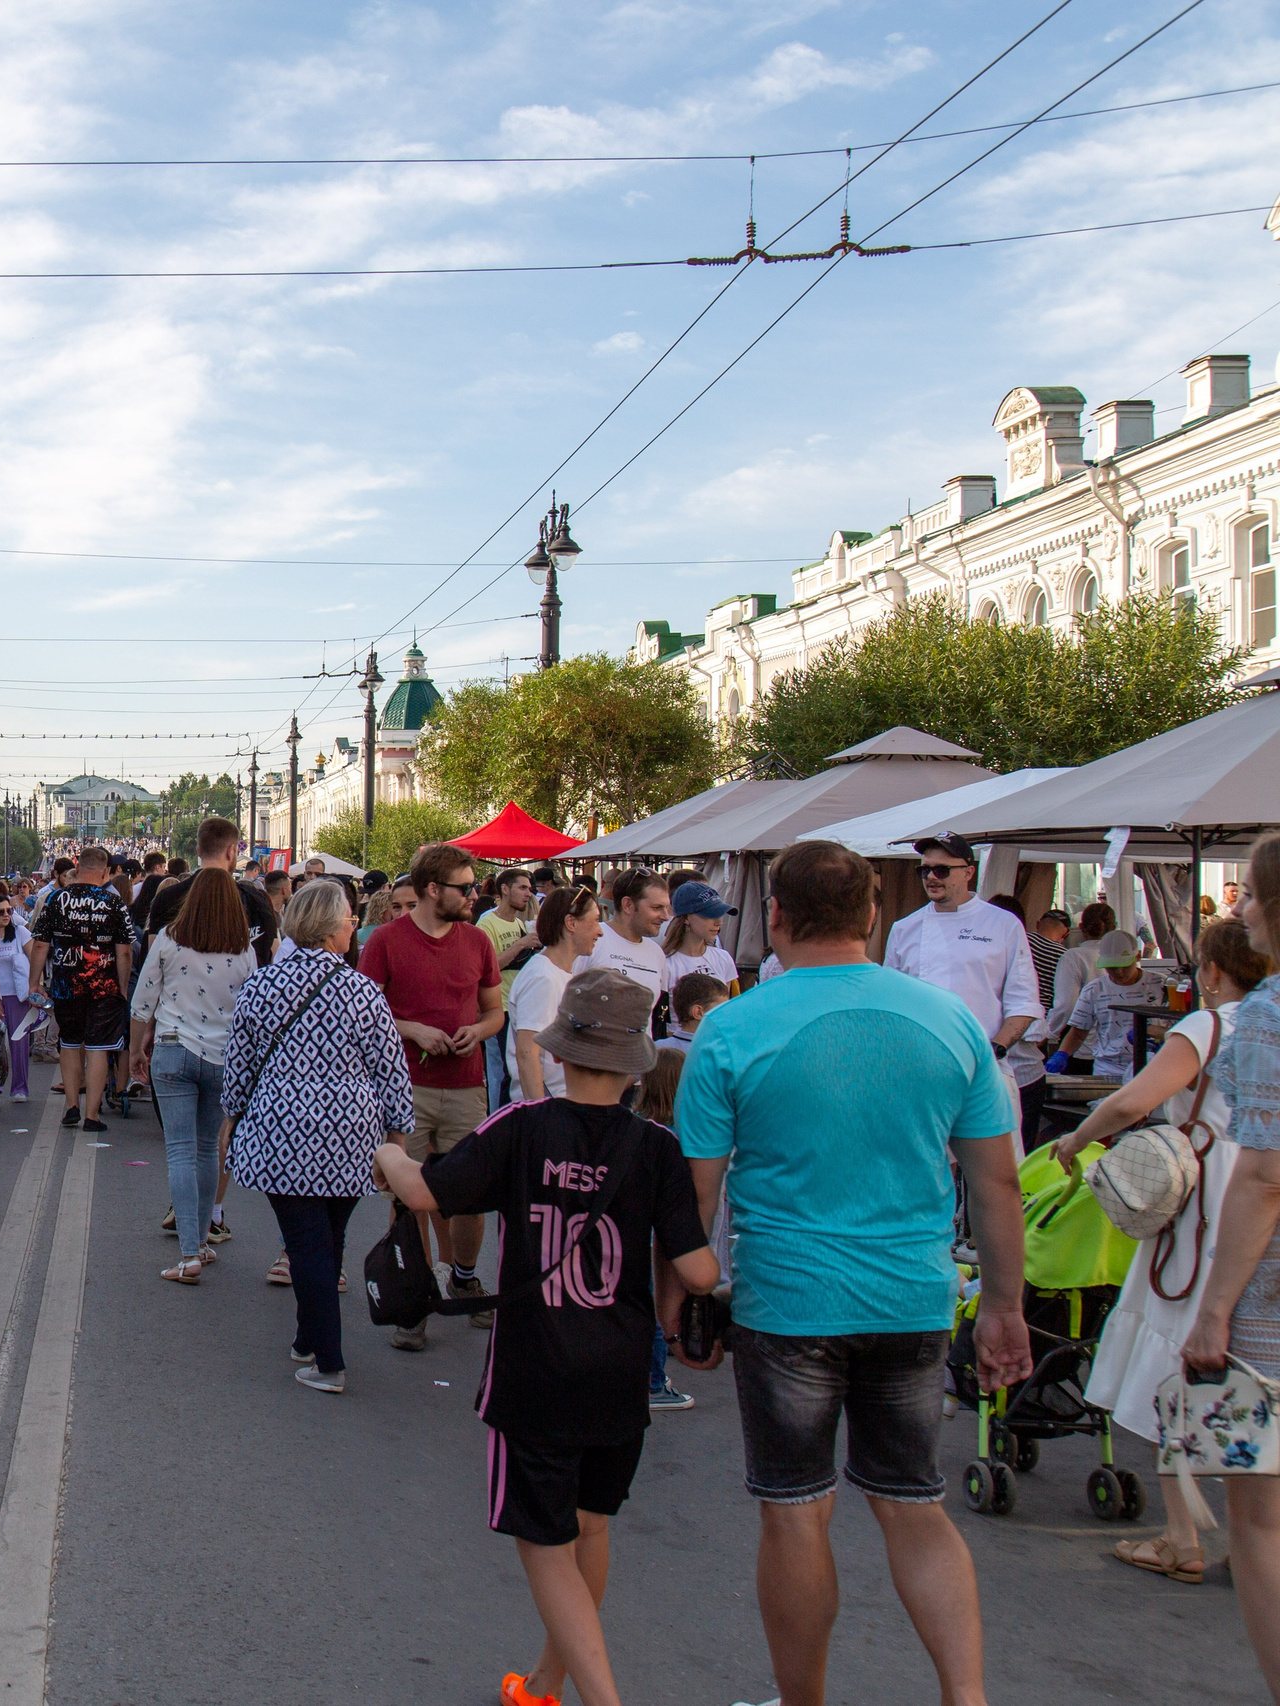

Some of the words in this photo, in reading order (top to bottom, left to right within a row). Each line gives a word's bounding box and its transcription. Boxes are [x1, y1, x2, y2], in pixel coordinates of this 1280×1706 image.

[57, 891, 112, 916] Puma
[609, 954, 634, 963] ORIGINAL
[529, 1203, 623, 1310] 10
